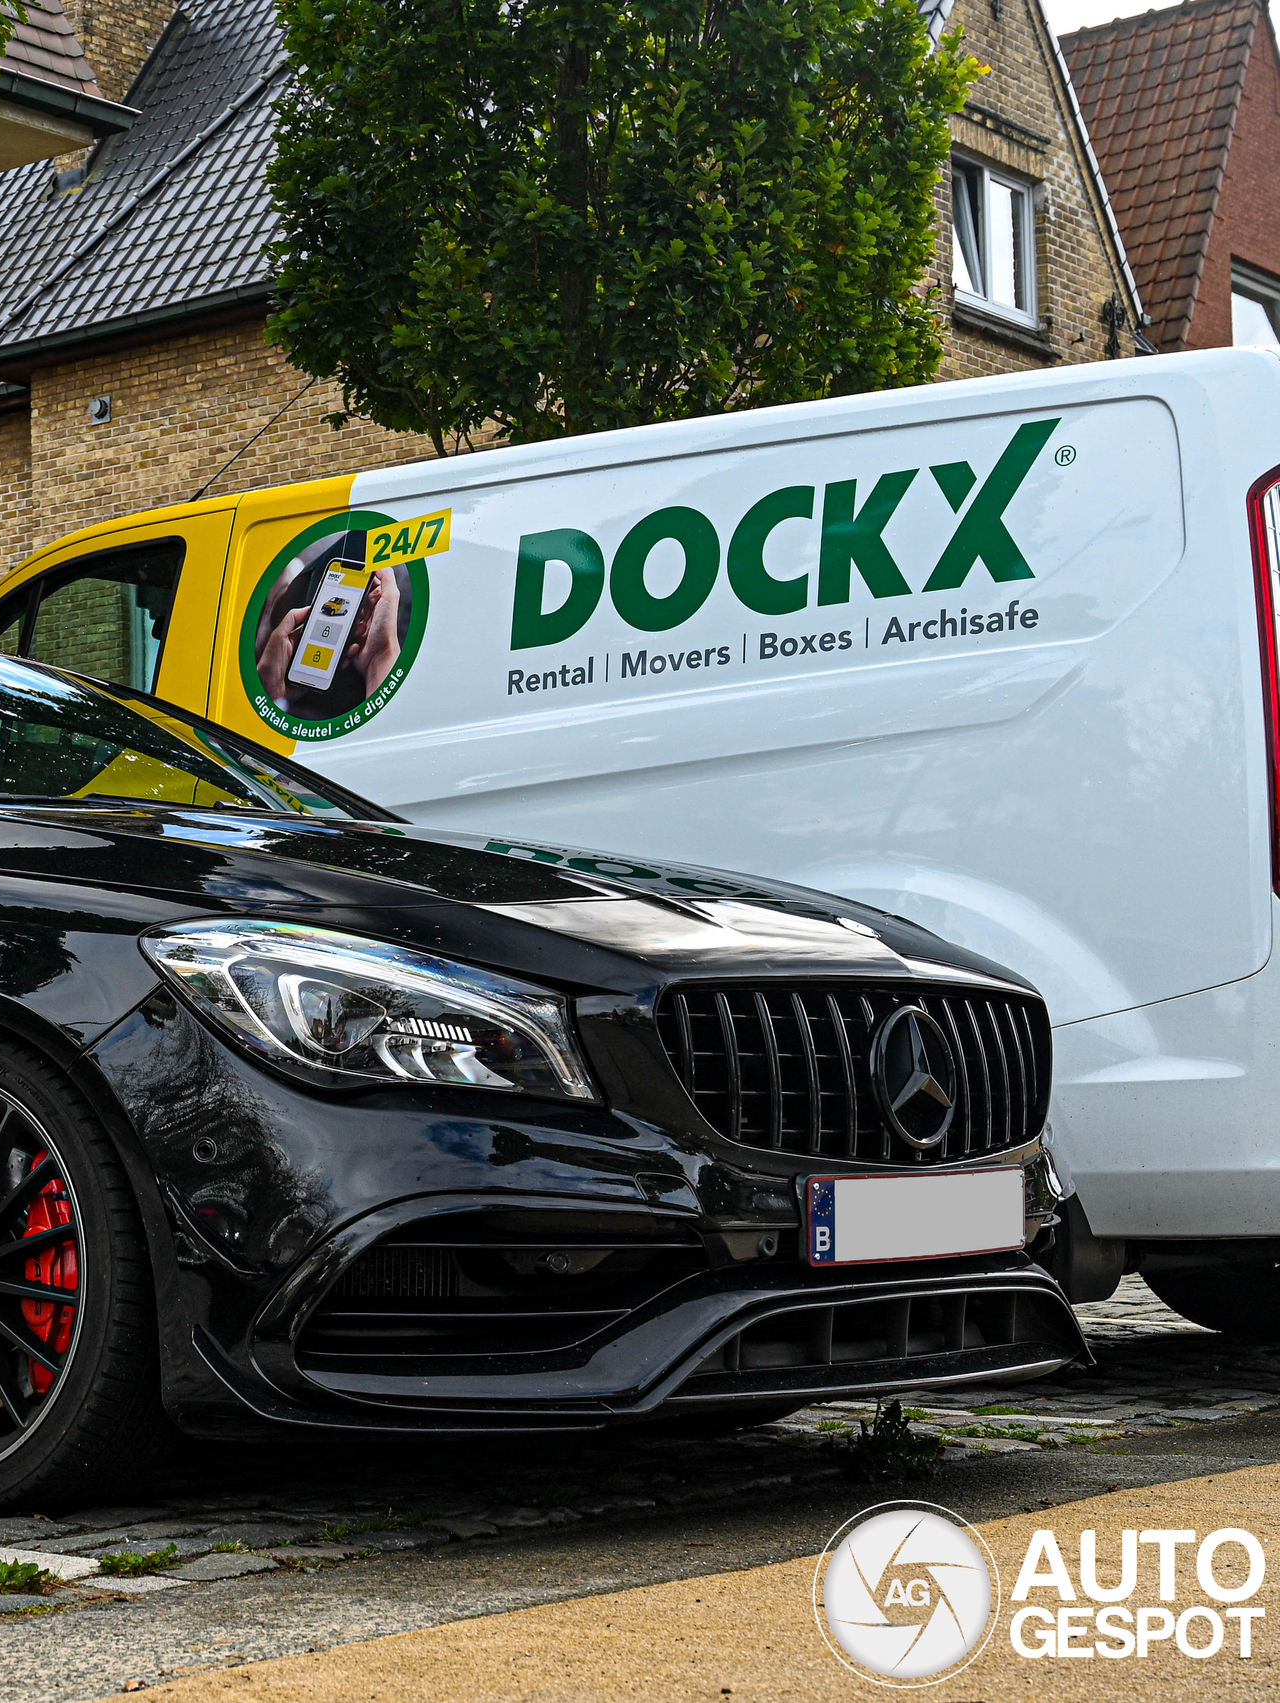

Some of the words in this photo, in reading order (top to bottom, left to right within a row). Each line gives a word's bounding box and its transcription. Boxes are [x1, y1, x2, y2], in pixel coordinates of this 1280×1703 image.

[372, 517, 445, 564] 24/7
[510, 417, 1062, 651] DOCKX
[506, 657, 594, 696] Rental
[621, 642, 731, 680] Movers
[759, 627, 853, 662] Boxes
[881, 600, 1040, 646] Archisafe
[255, 695, 289, 732] digitale
[292, 722, 332, 738] sleutel
[344, 713, 361, 730] clé
[364, 668, 403, 717] digitale
[816, 1226, 831, 1251] B
